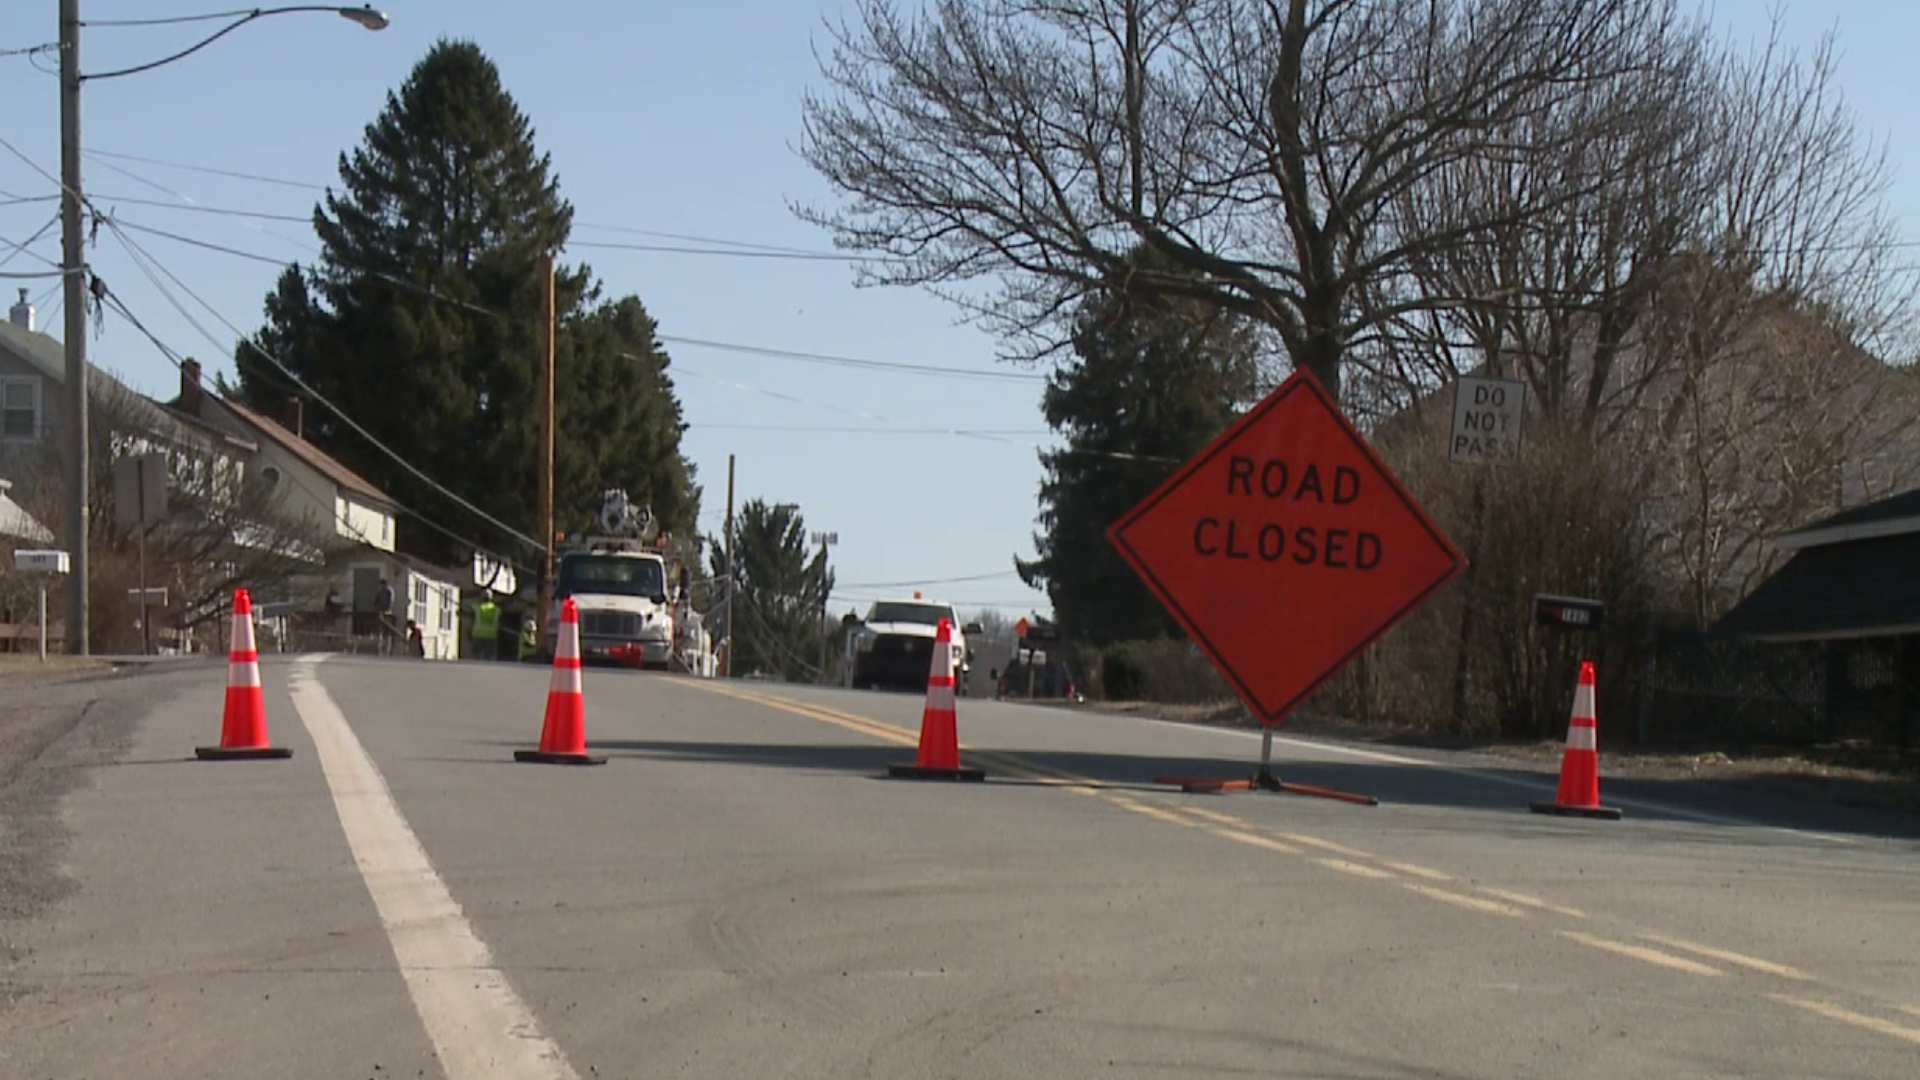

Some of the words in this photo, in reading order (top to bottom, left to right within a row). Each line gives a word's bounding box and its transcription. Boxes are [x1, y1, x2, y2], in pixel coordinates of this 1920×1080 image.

[1475, 385, 1505, 407] DO
[1464, 410, 1510, 433] NOT
[1454, 435, 1514, 459] PASS
[1228, 456, 1361, 505] ROAD
[1193, 518, 1382, 570] CLOSED
